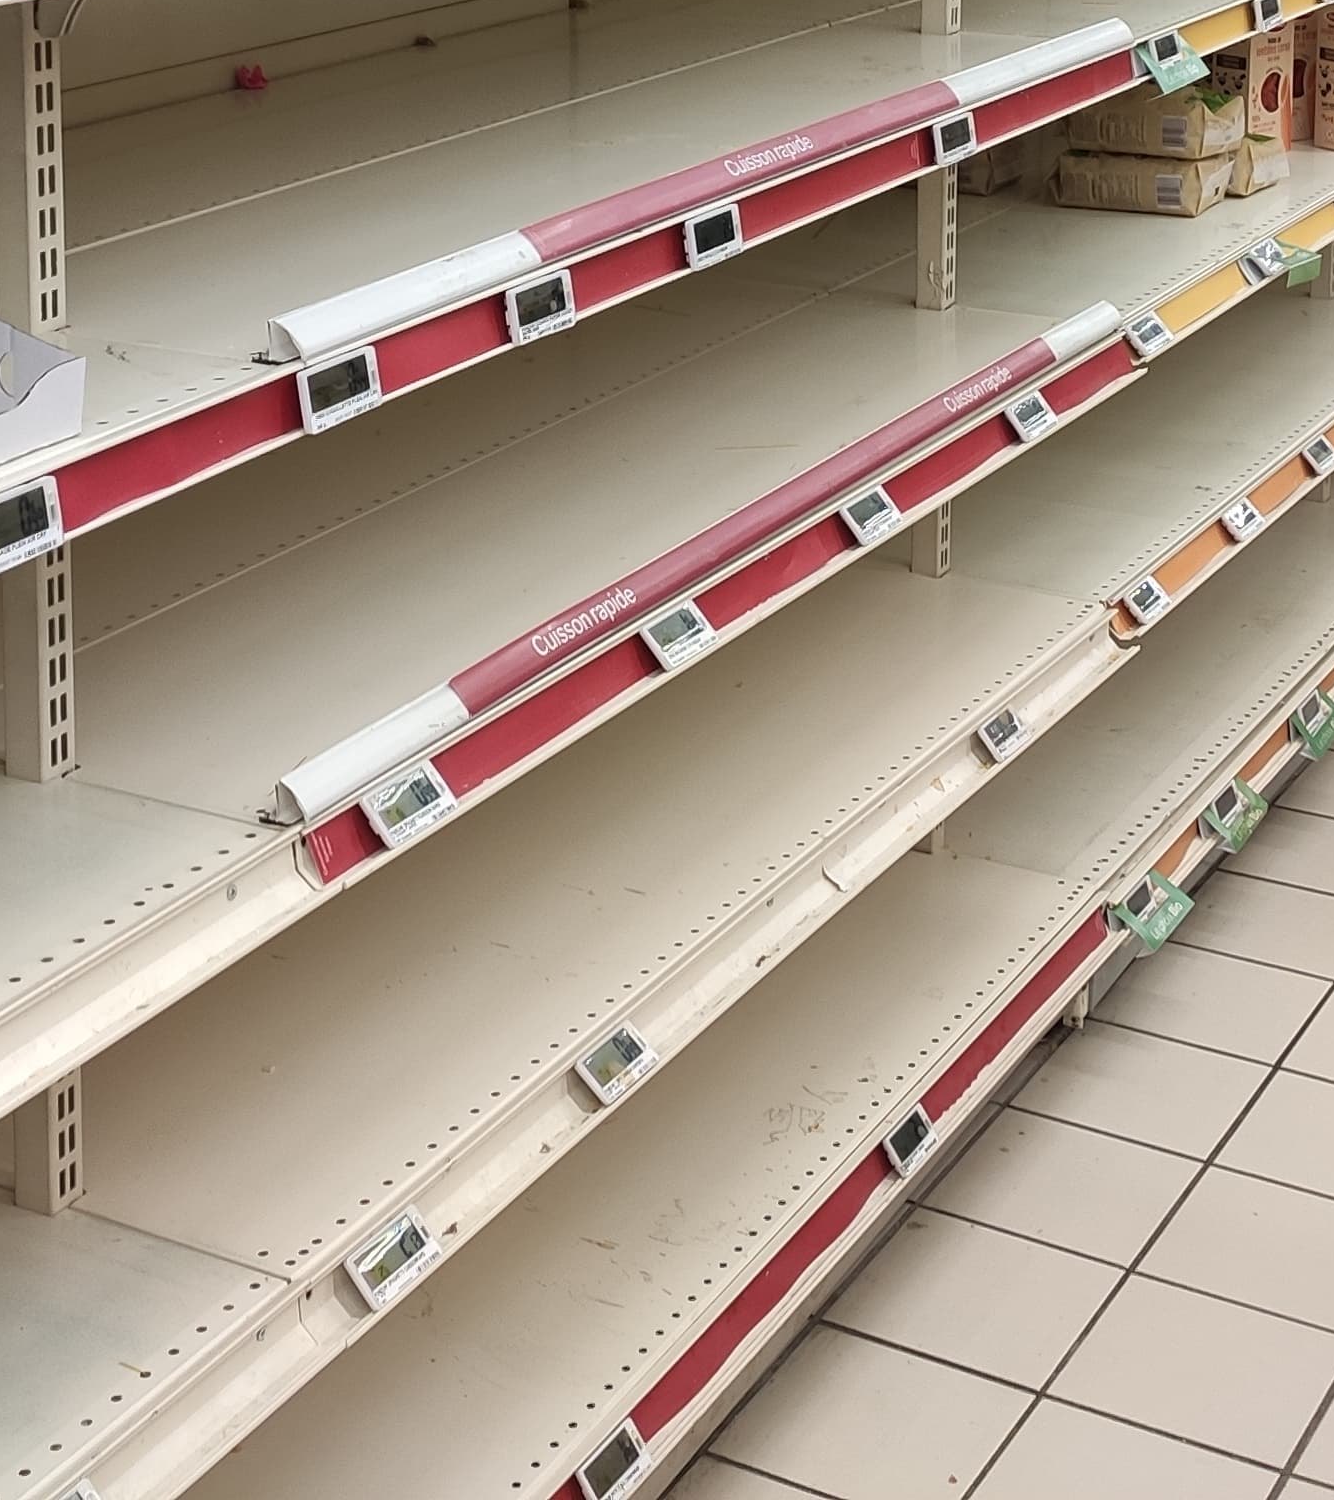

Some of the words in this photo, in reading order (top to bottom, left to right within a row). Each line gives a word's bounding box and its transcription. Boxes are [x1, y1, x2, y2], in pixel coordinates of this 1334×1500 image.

[724, 147, 777, 176] Cuisson
[774, 134, 814, 161] rapide
[943, 383, 985, 413] Cuisson
[981, 365, 1013, 393] rapide
[531, 612, 594, 656] Cuisson
[590, 587, 637, 623] rapide
